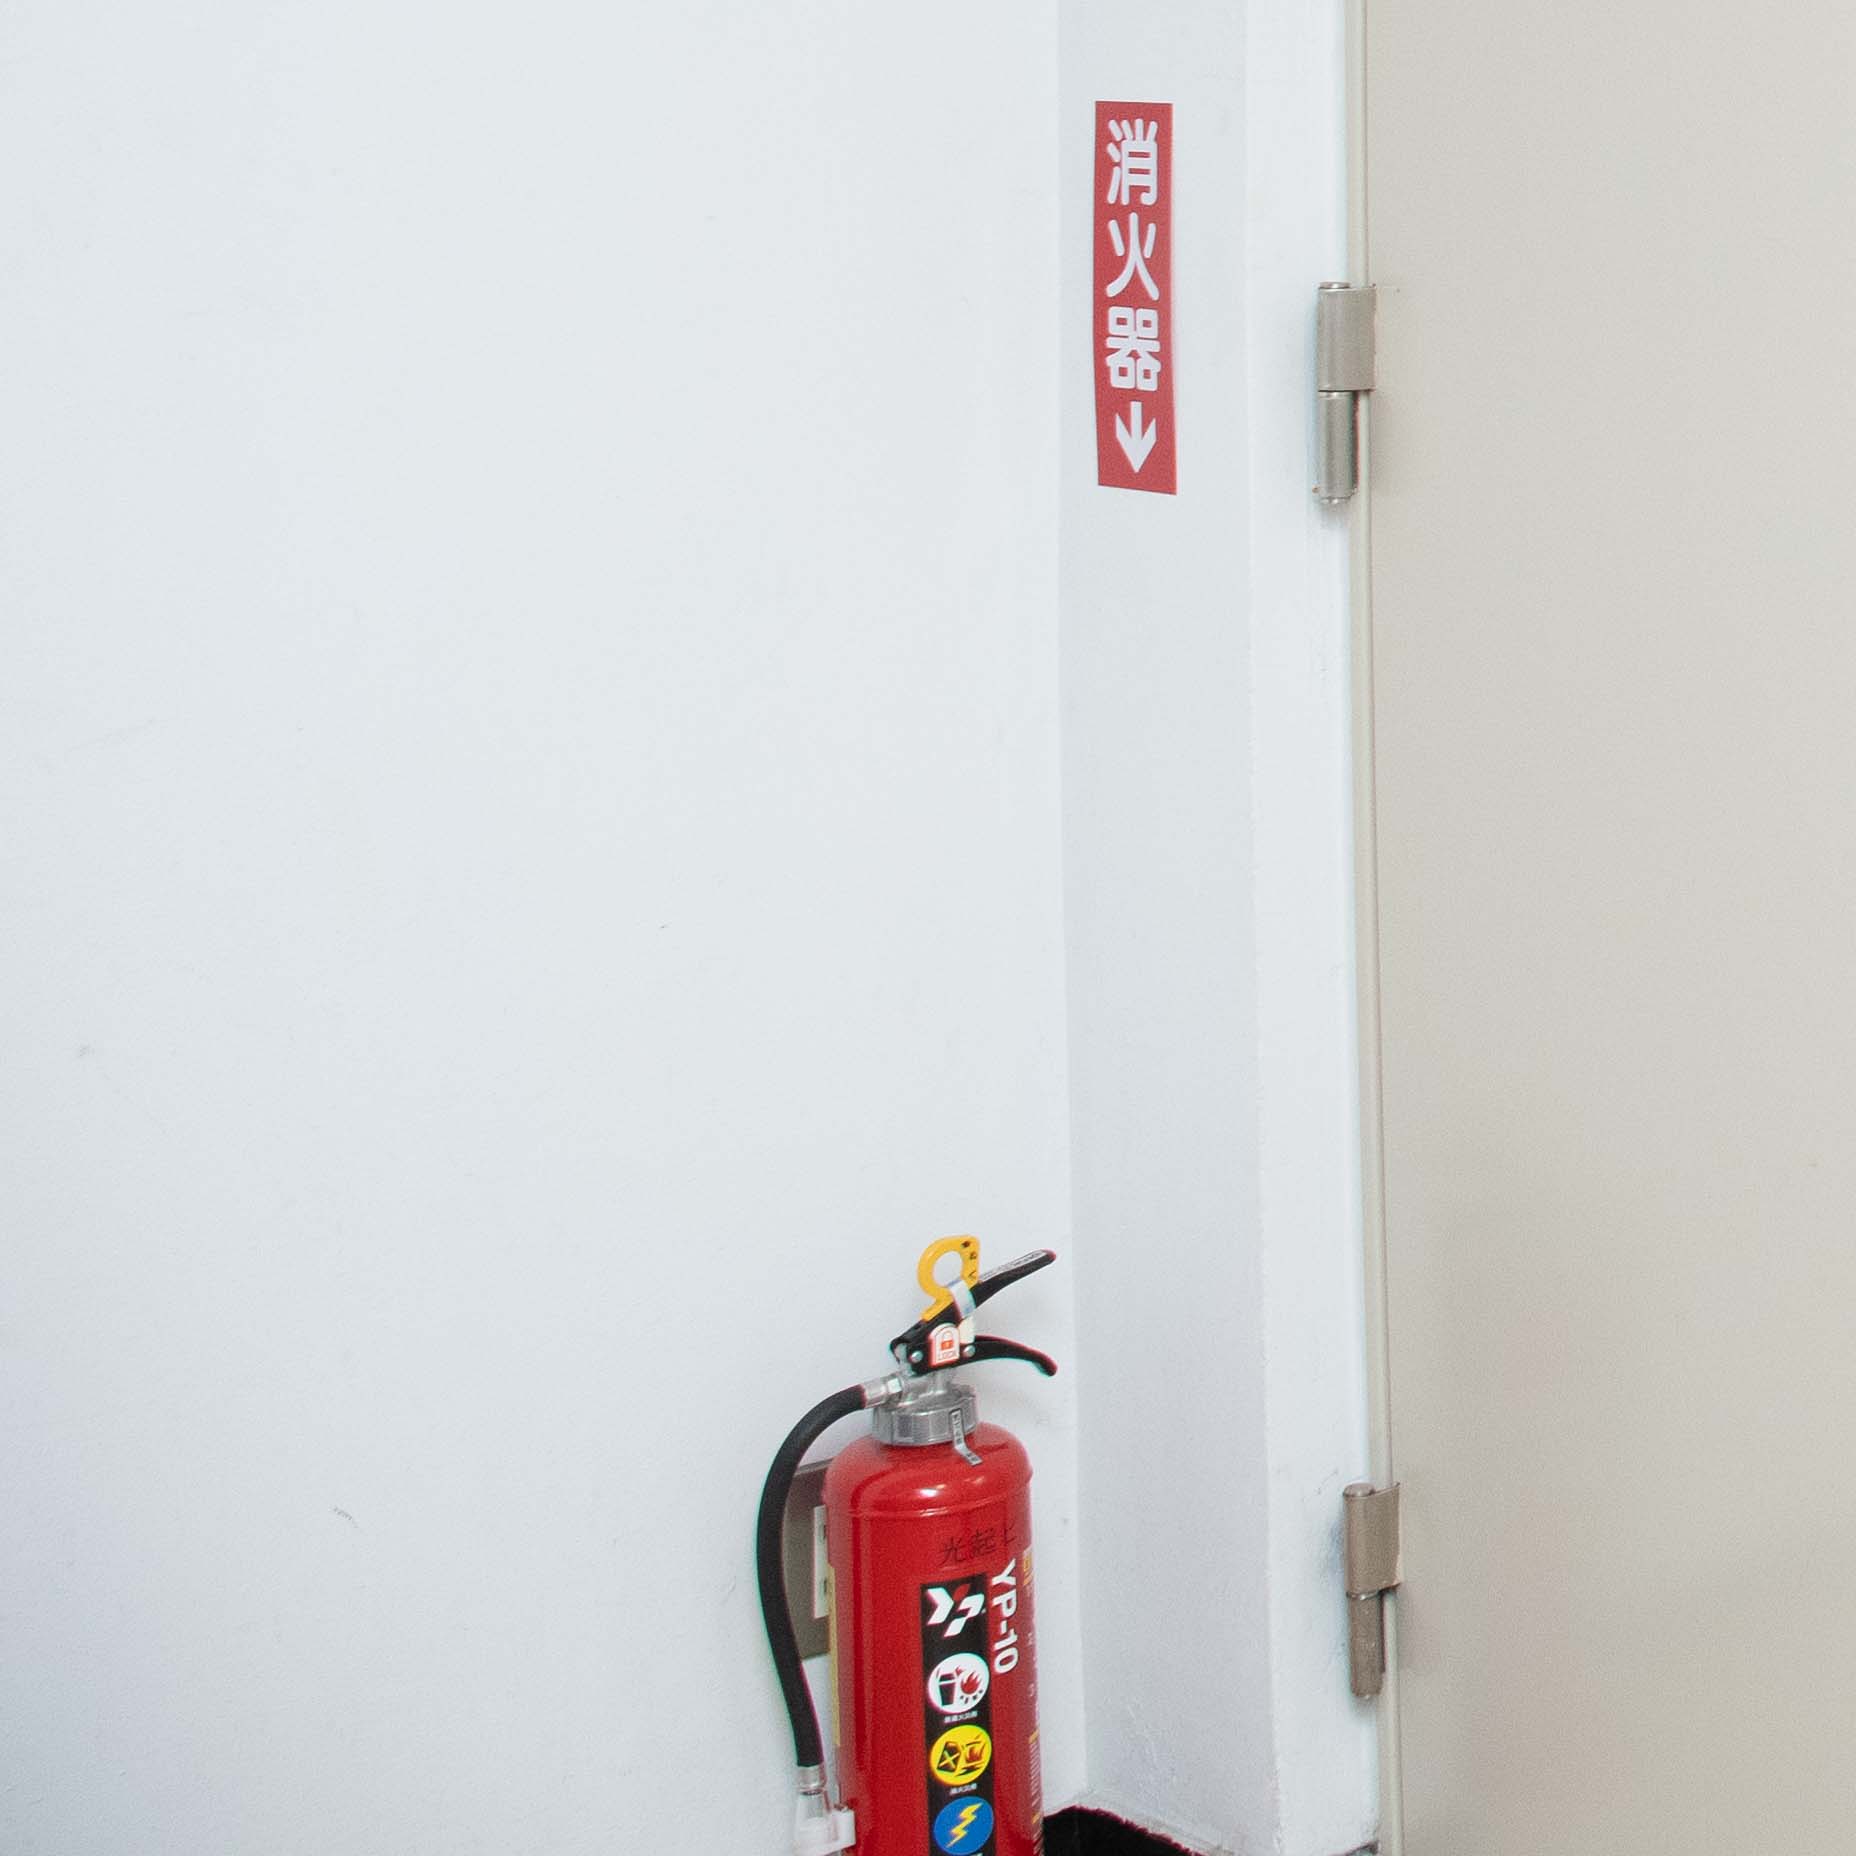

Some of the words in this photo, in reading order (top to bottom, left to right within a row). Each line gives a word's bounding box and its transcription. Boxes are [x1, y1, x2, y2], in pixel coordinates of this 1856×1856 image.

[1105, 118, 1161, 392] 消火器
[991, 1558, 1019, 1674] YP-10
